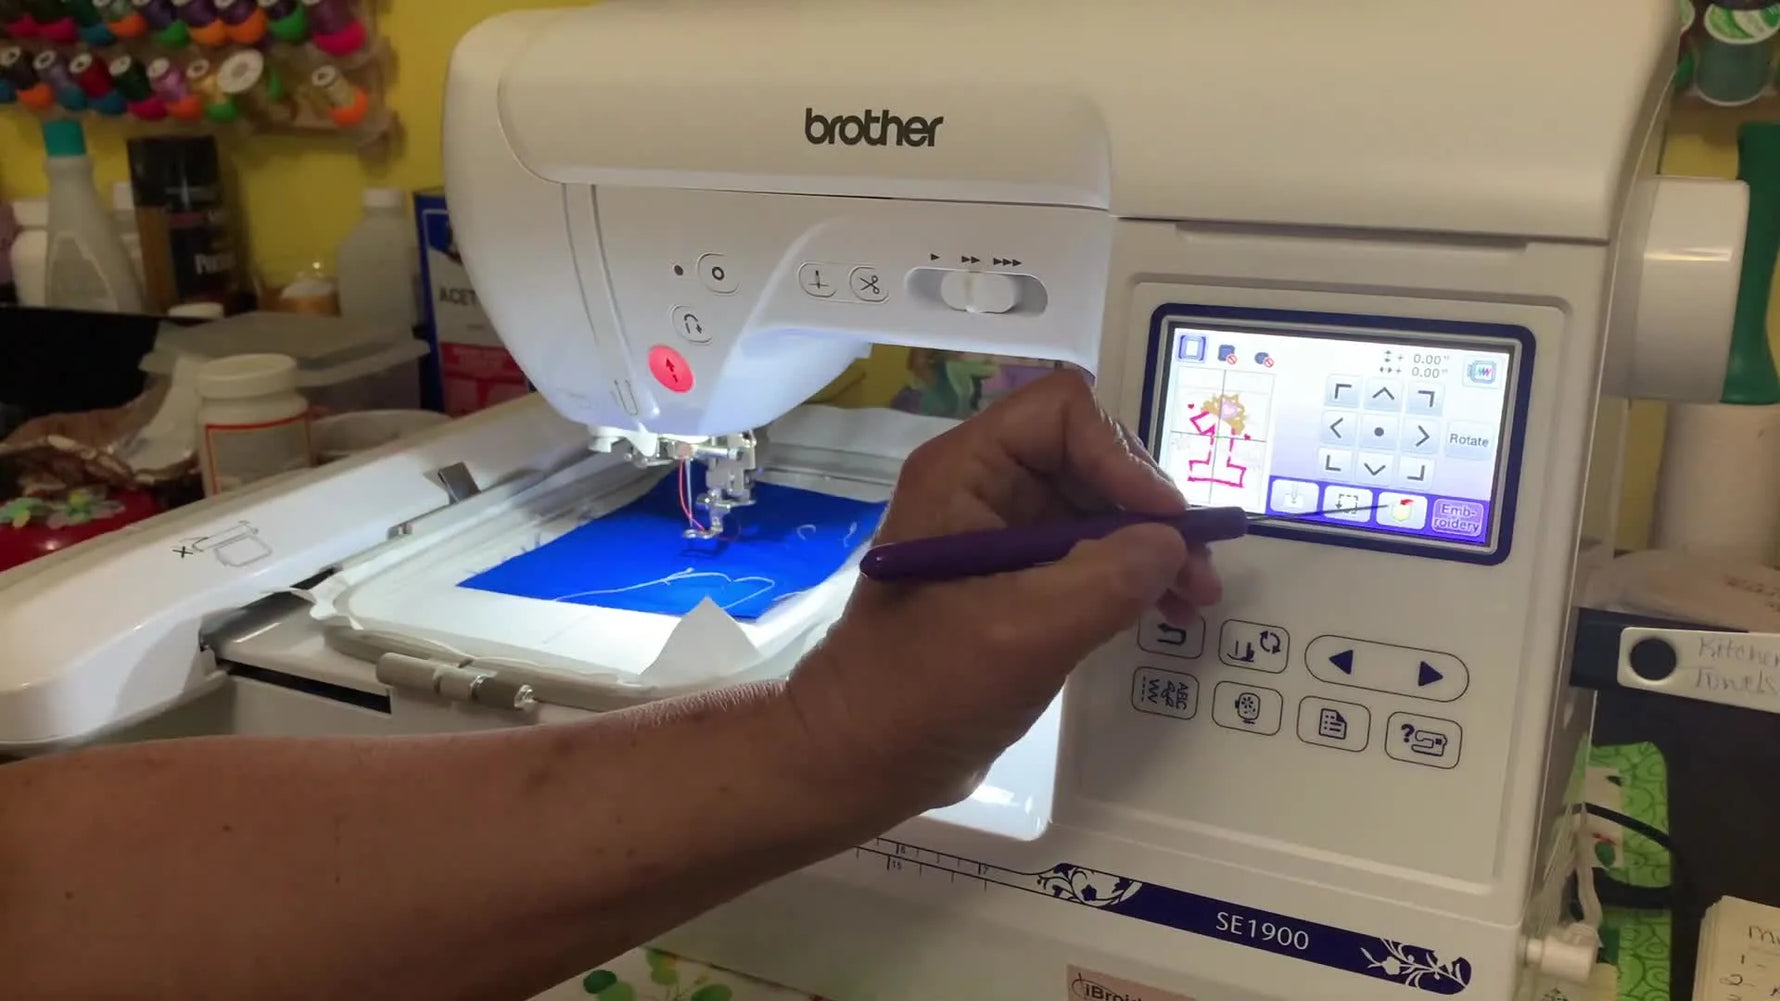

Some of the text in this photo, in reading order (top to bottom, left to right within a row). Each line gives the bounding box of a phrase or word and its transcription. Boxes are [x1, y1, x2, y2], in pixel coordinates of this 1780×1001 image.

[805, 107, 944, 147] brother
[1449, 433, 1489, 447] Rotate
[1442, 503, 1476, 516] Emb-
[1434, 518, 1479, 532] roidery
[1216, 911, 1309, 950] SE1900
